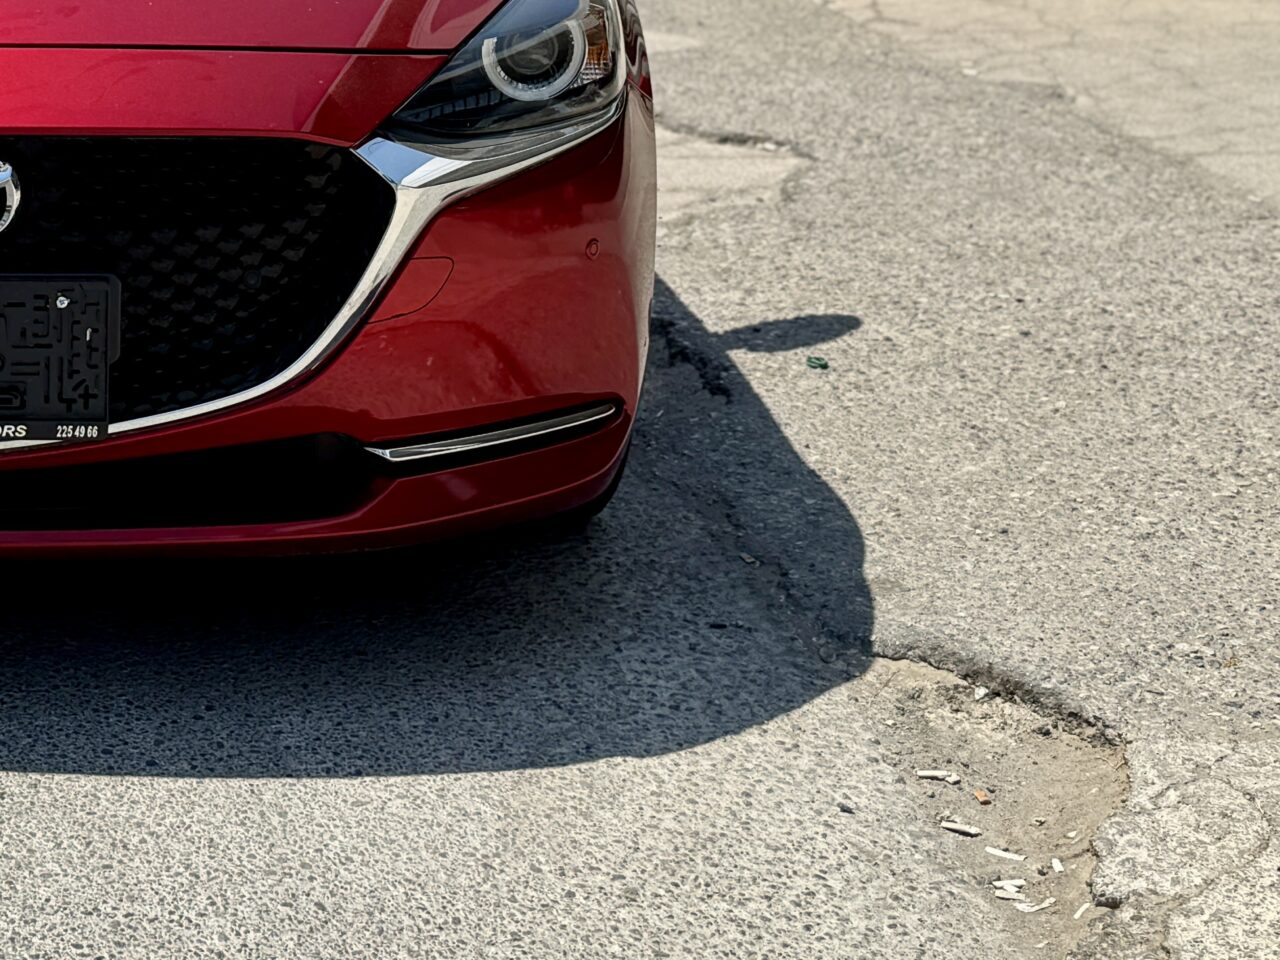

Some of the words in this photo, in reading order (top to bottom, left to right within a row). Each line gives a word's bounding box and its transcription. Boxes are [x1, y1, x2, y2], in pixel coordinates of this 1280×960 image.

[56, 425, 73, 438] 225
[74, 425, 86, 438] 49
[87, 425, 98, 438] 66
